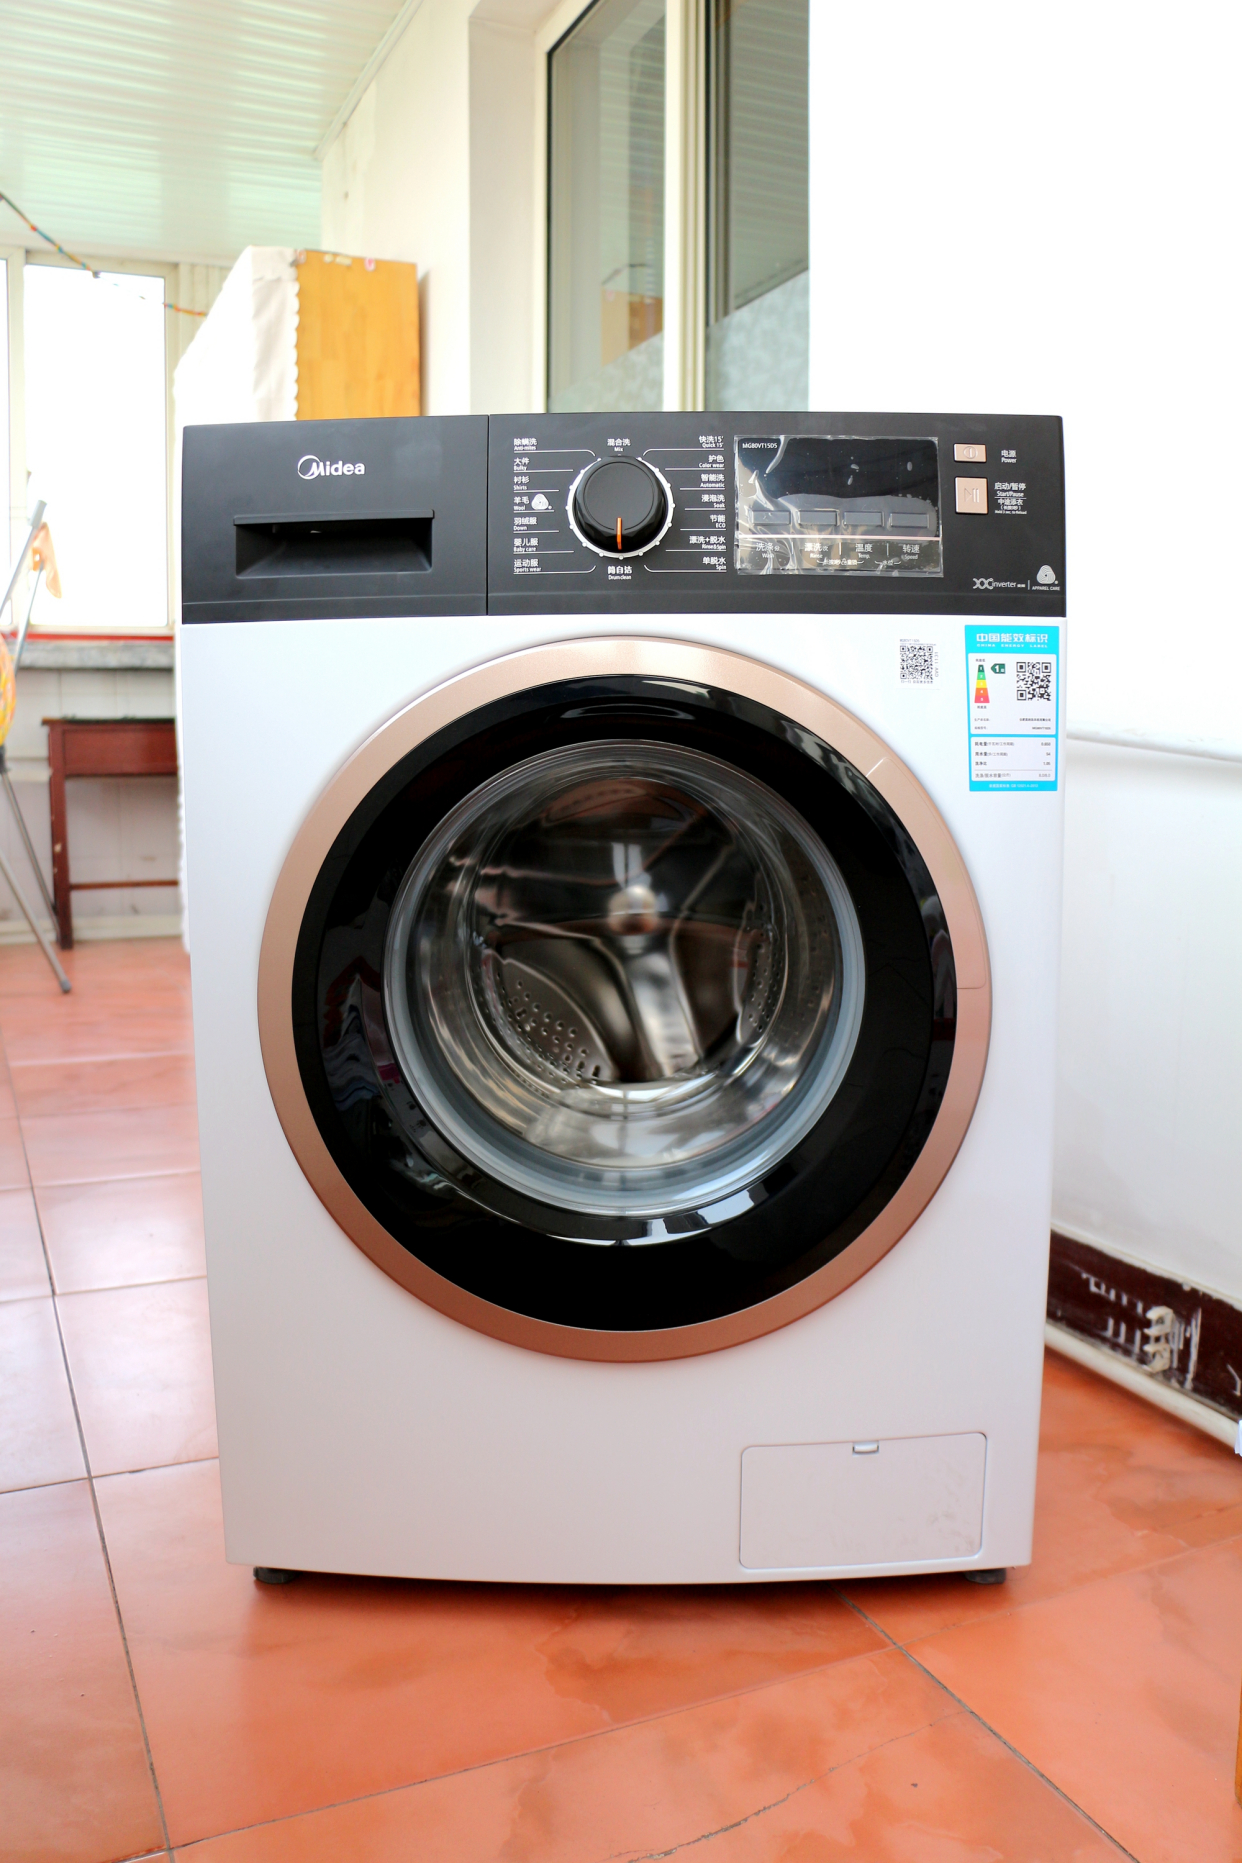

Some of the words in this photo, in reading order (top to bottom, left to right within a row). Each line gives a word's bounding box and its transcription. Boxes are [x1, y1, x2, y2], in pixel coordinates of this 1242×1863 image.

[607, 438, 631, 446] 混合洗
[1001, 450, 1017, 458] 电源
[514, 457, 530, 465] 大件
[708, 455, 725, 463] 护色
[298, 457, 365, 478] Midea
[514, 476, 530, 484] 衬衫
[700, 474, 725, 482] 智能洗
[994, 482, 1026, 490] 启动/暂停
[514, 496, 530, 504] 羊毛
[701, 494, 725, 503] 浸泡洗
[514, 517, 537, 525] 羽绒服
[709, 515, 726, 523] 节能
[514, 538, 538, 546] 婴儿服
[689, 536, 726, 544] 漂洗+脱水
[855, 543, 873, 552] 温度
[902, 544, 920, 553] 转速
[514, 559, 538, 567] 运动服
[702, 557, 726, 565] 单脱水
[607, 565, 632, 574] 筒自洁
[976, 633, 1048, 643] 中国能效标识
